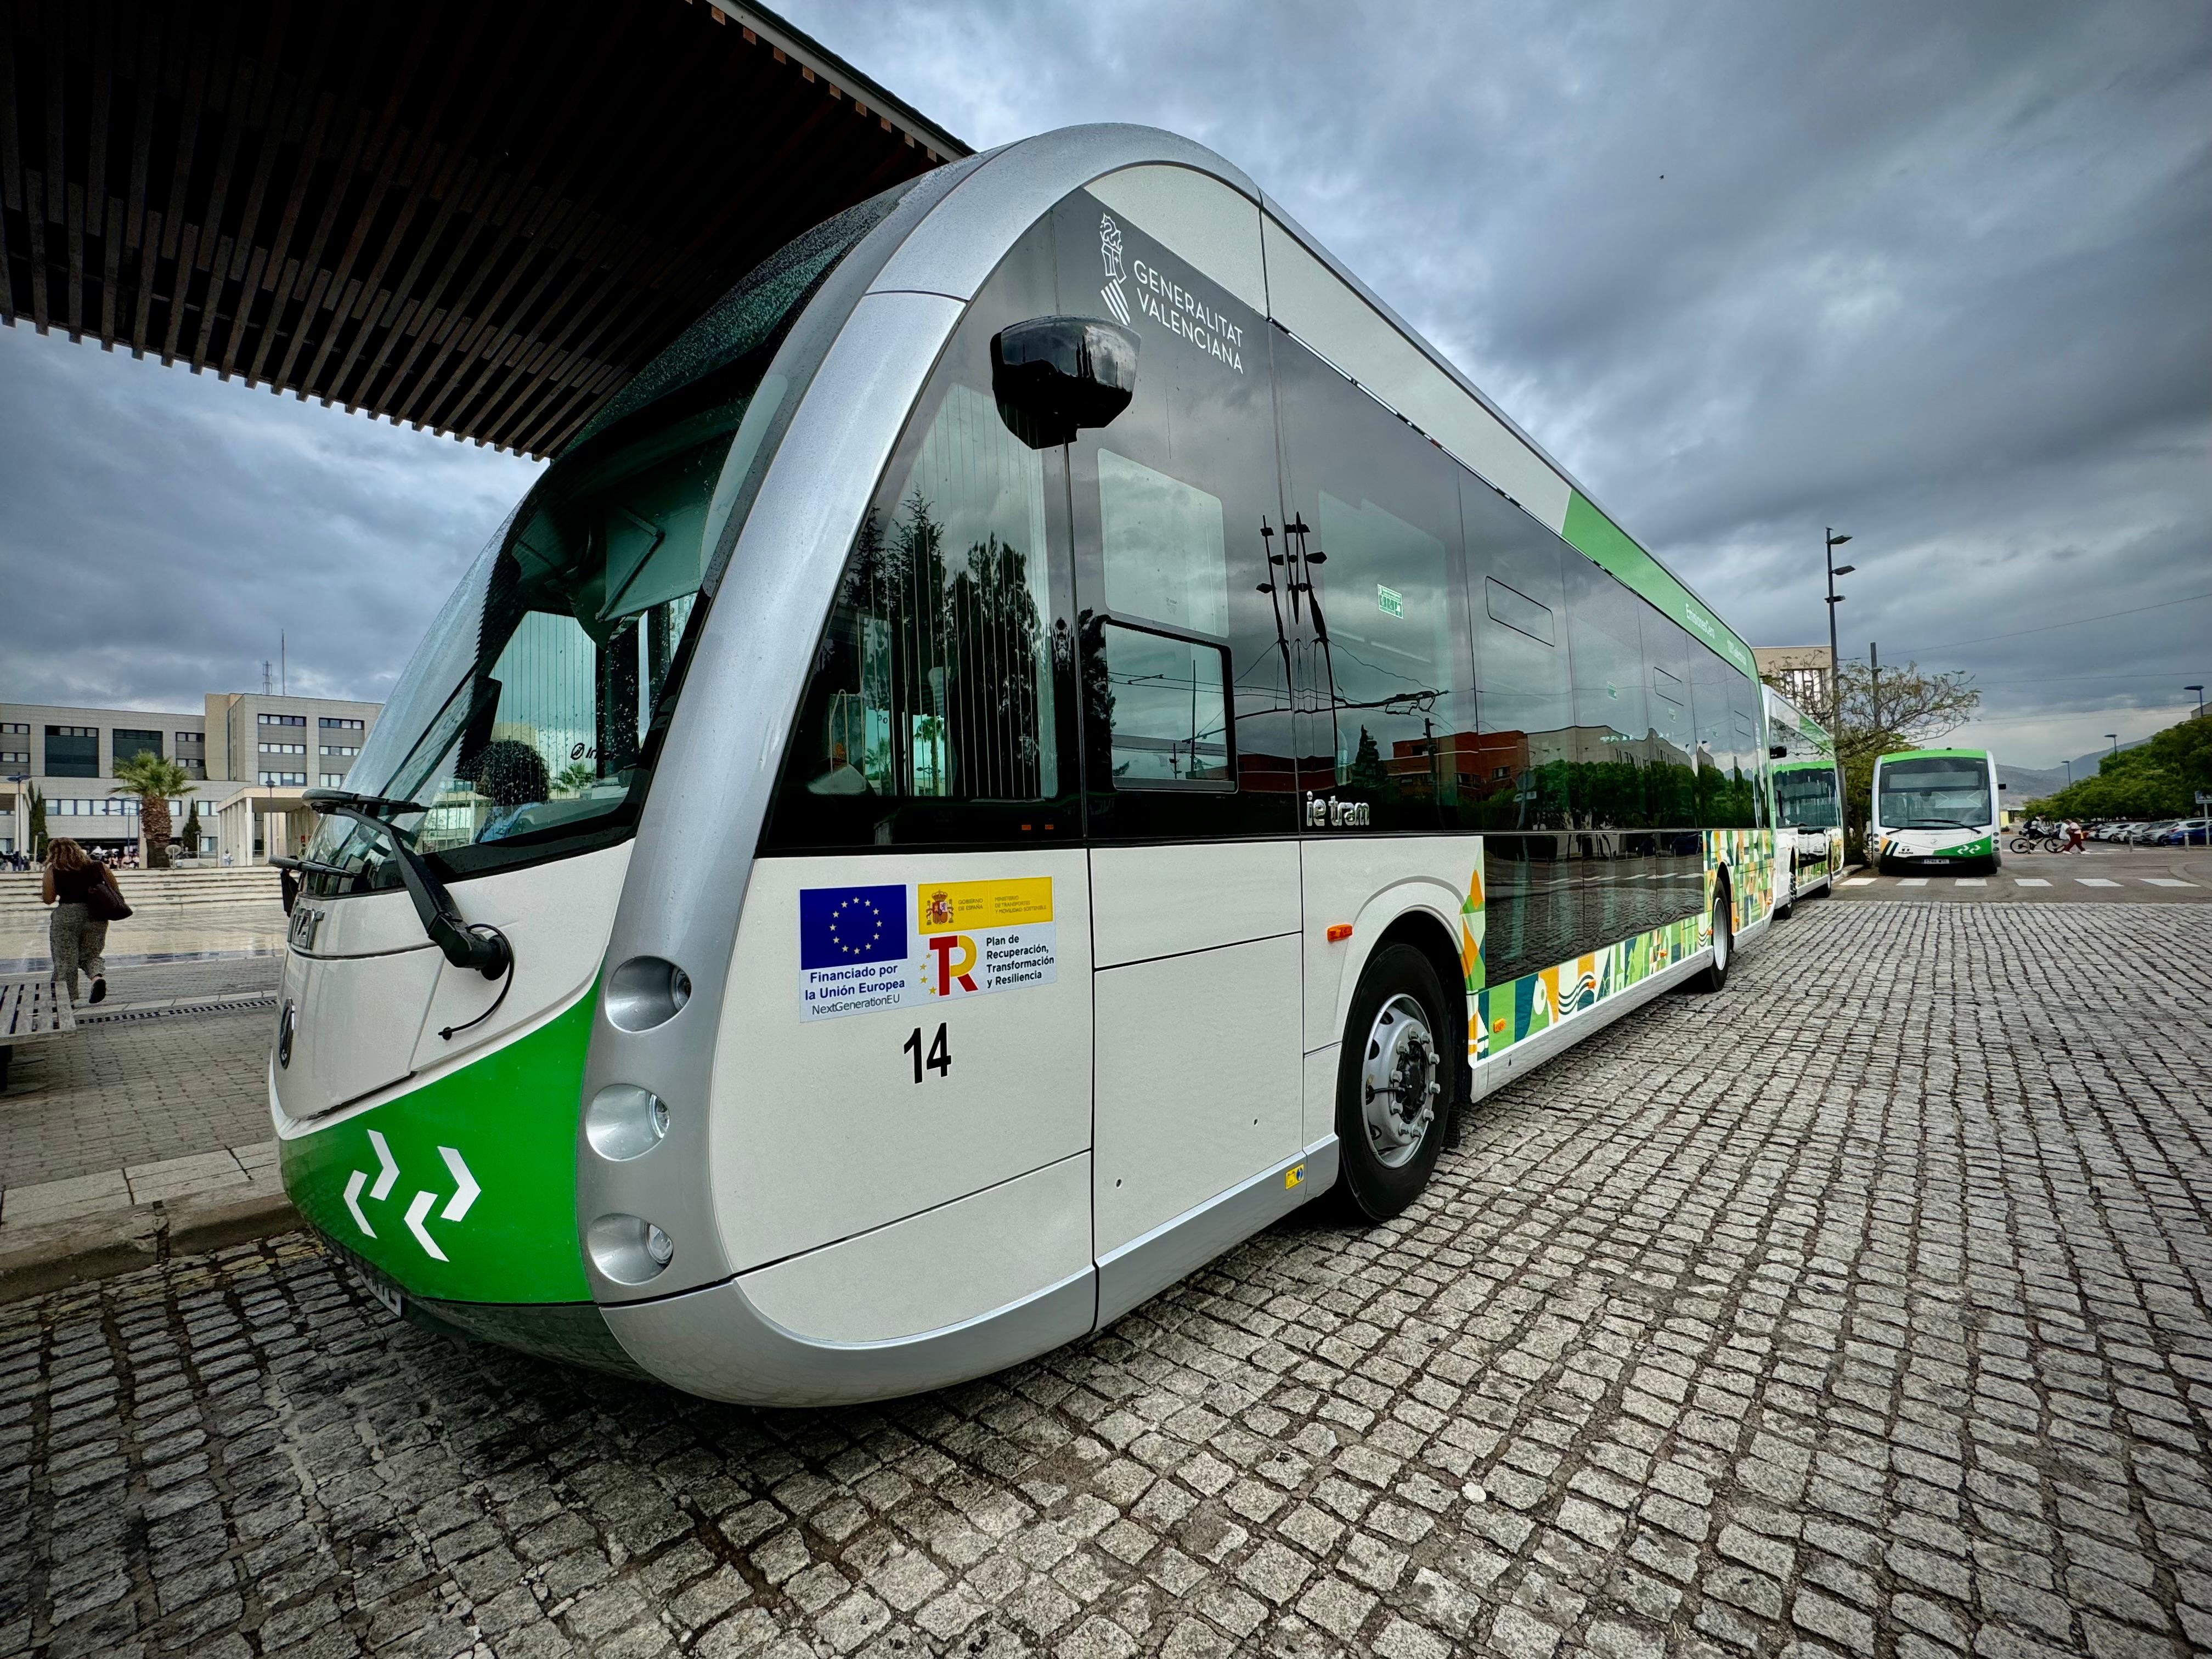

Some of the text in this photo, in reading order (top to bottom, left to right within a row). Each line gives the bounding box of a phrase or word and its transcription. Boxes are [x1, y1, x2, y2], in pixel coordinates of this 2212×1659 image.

[1133, 260, 1243, 348] GENERALITAT
[1137, 287, 1244, 374] VALENCIANA
[1307, 791, 1369, 826] ie tram
[986, 934, 1019, 946] Plan de
[987, 944, 1049, 960] Recuperación,
[810, 965, 898, 983] Financiado por
[986, 956, 1054, 973] Transformación
[805, 979, 905, 1000] la Unión Europea
[987, 970, 1042, 989] y Resiliencia
[812, 994, 900, 1015] NextGenerationEU
[904, 1022, 952, 1084] 14
